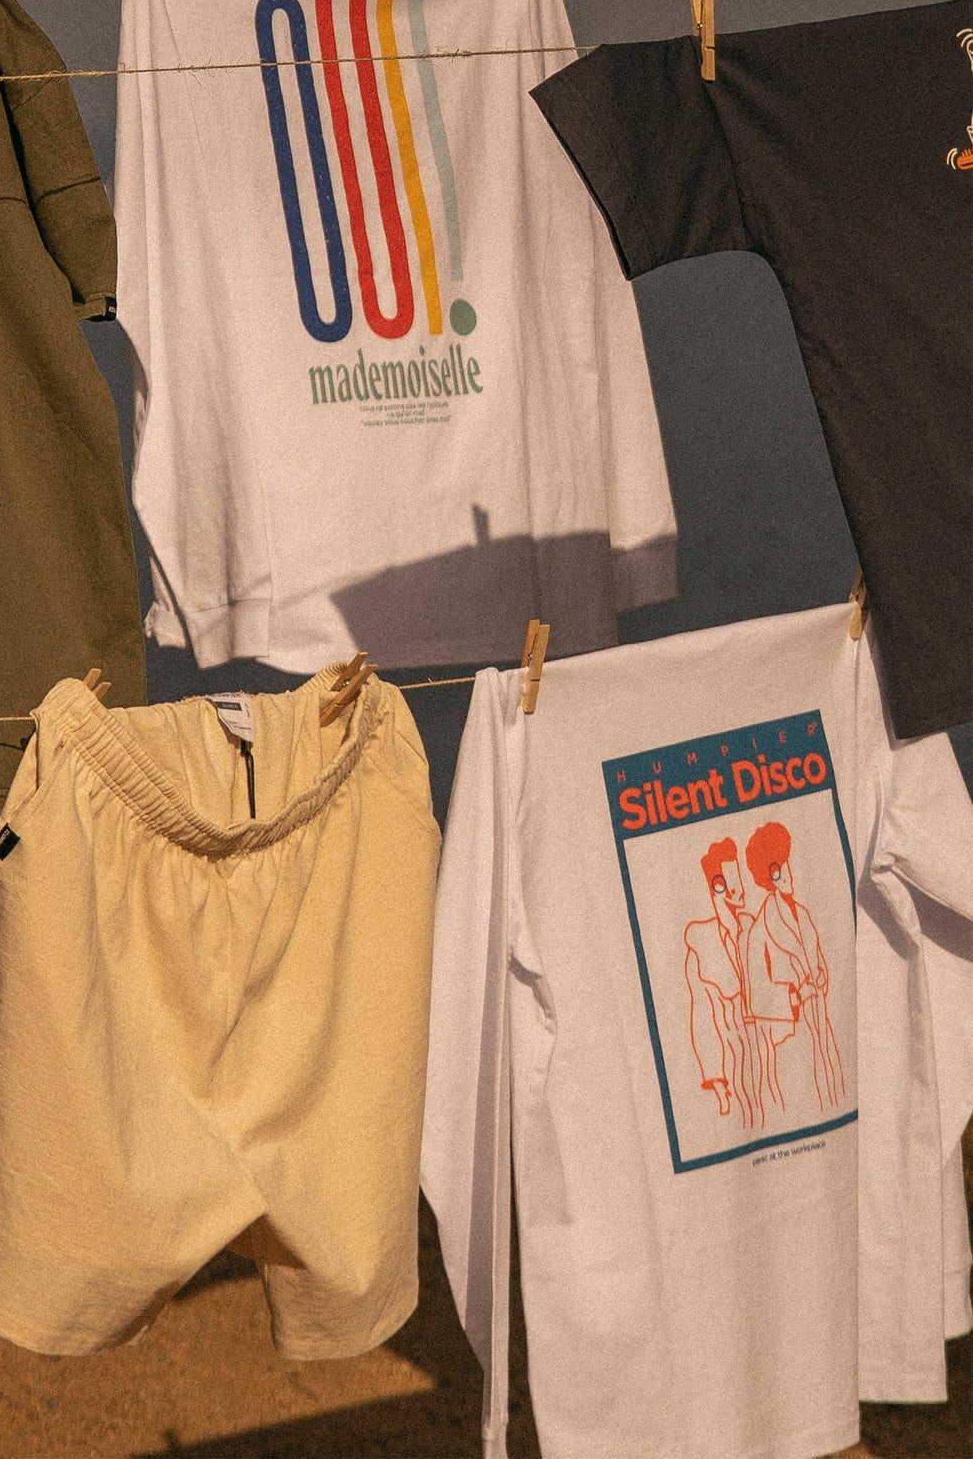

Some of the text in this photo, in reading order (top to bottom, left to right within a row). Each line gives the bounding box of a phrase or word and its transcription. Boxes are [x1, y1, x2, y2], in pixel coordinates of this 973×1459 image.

[308, 343, 483, 405] mademoiselle
[618, 752, 827, 831] Silent Disco
